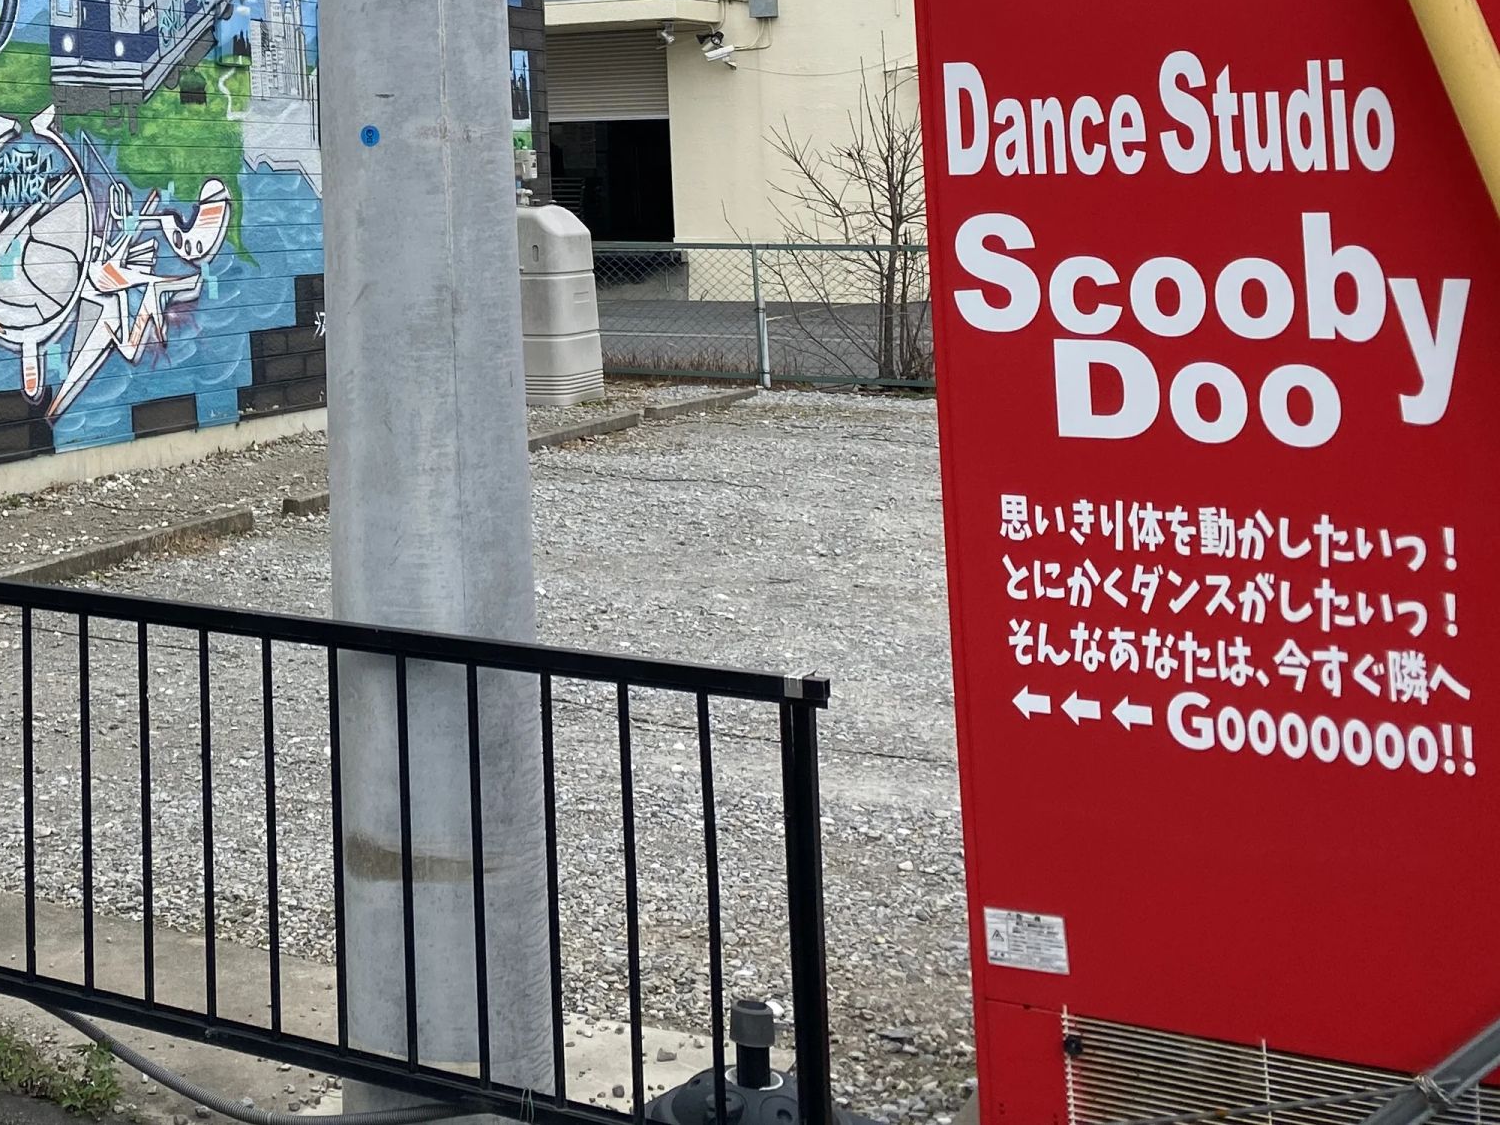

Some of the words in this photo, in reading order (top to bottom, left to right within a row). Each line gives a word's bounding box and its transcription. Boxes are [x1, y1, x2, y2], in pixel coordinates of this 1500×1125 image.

[943, 62, 1146, 176] Dance
[1159, 50, 1395, 174] Studio
[953, 212, 1472, 425] Scooby
[1053, 338, 1342, 449] Doo
[999, 494, 1457, 572] 思いきり体を動かしたいっ！
[1001, 555, 1459, 637] とにかくダンスがしたいっ！
[1008, 618, 1471, 705] そんなあなたは、今すぐ隣へ
